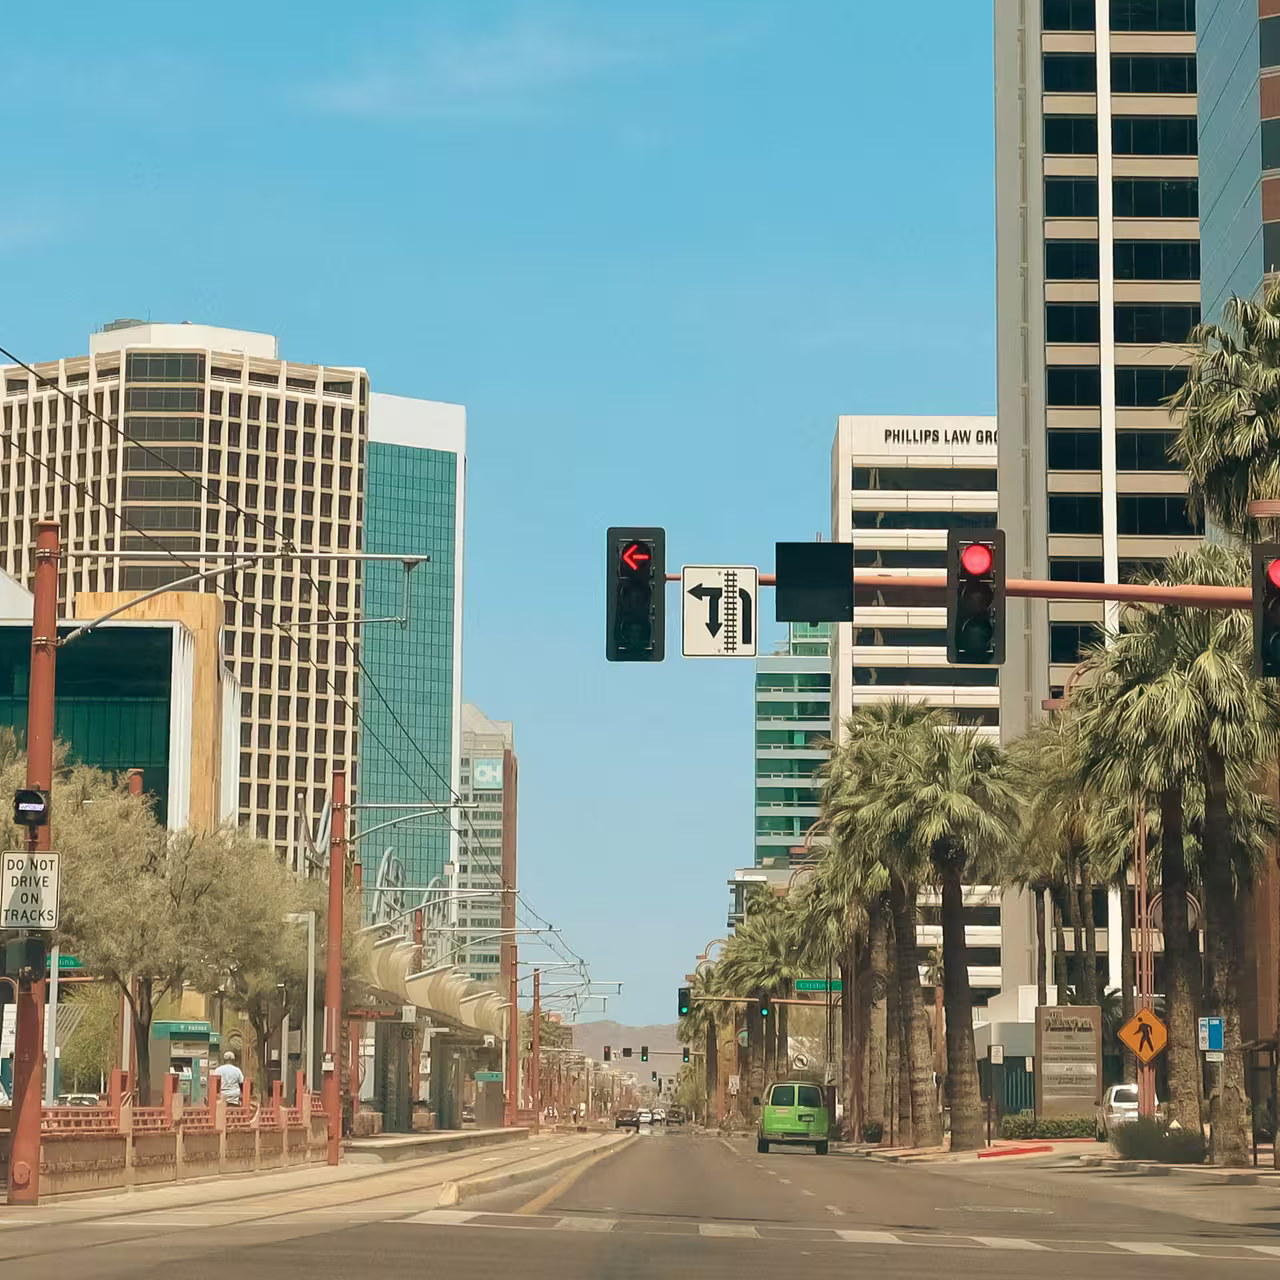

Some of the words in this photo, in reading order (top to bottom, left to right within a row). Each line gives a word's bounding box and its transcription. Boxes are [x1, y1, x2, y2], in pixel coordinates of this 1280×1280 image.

[884, 429, 940, 444] PHILLIPS
[944, 429, 971, 444] LAW
[7, 859, 24, 871] DO
[30, 859, 55, 871] NOT
[11, 876, 49, 888] DRIVE
[20, 892, 39, 904] ON
[4, 909, 54, 921] TRACKS
